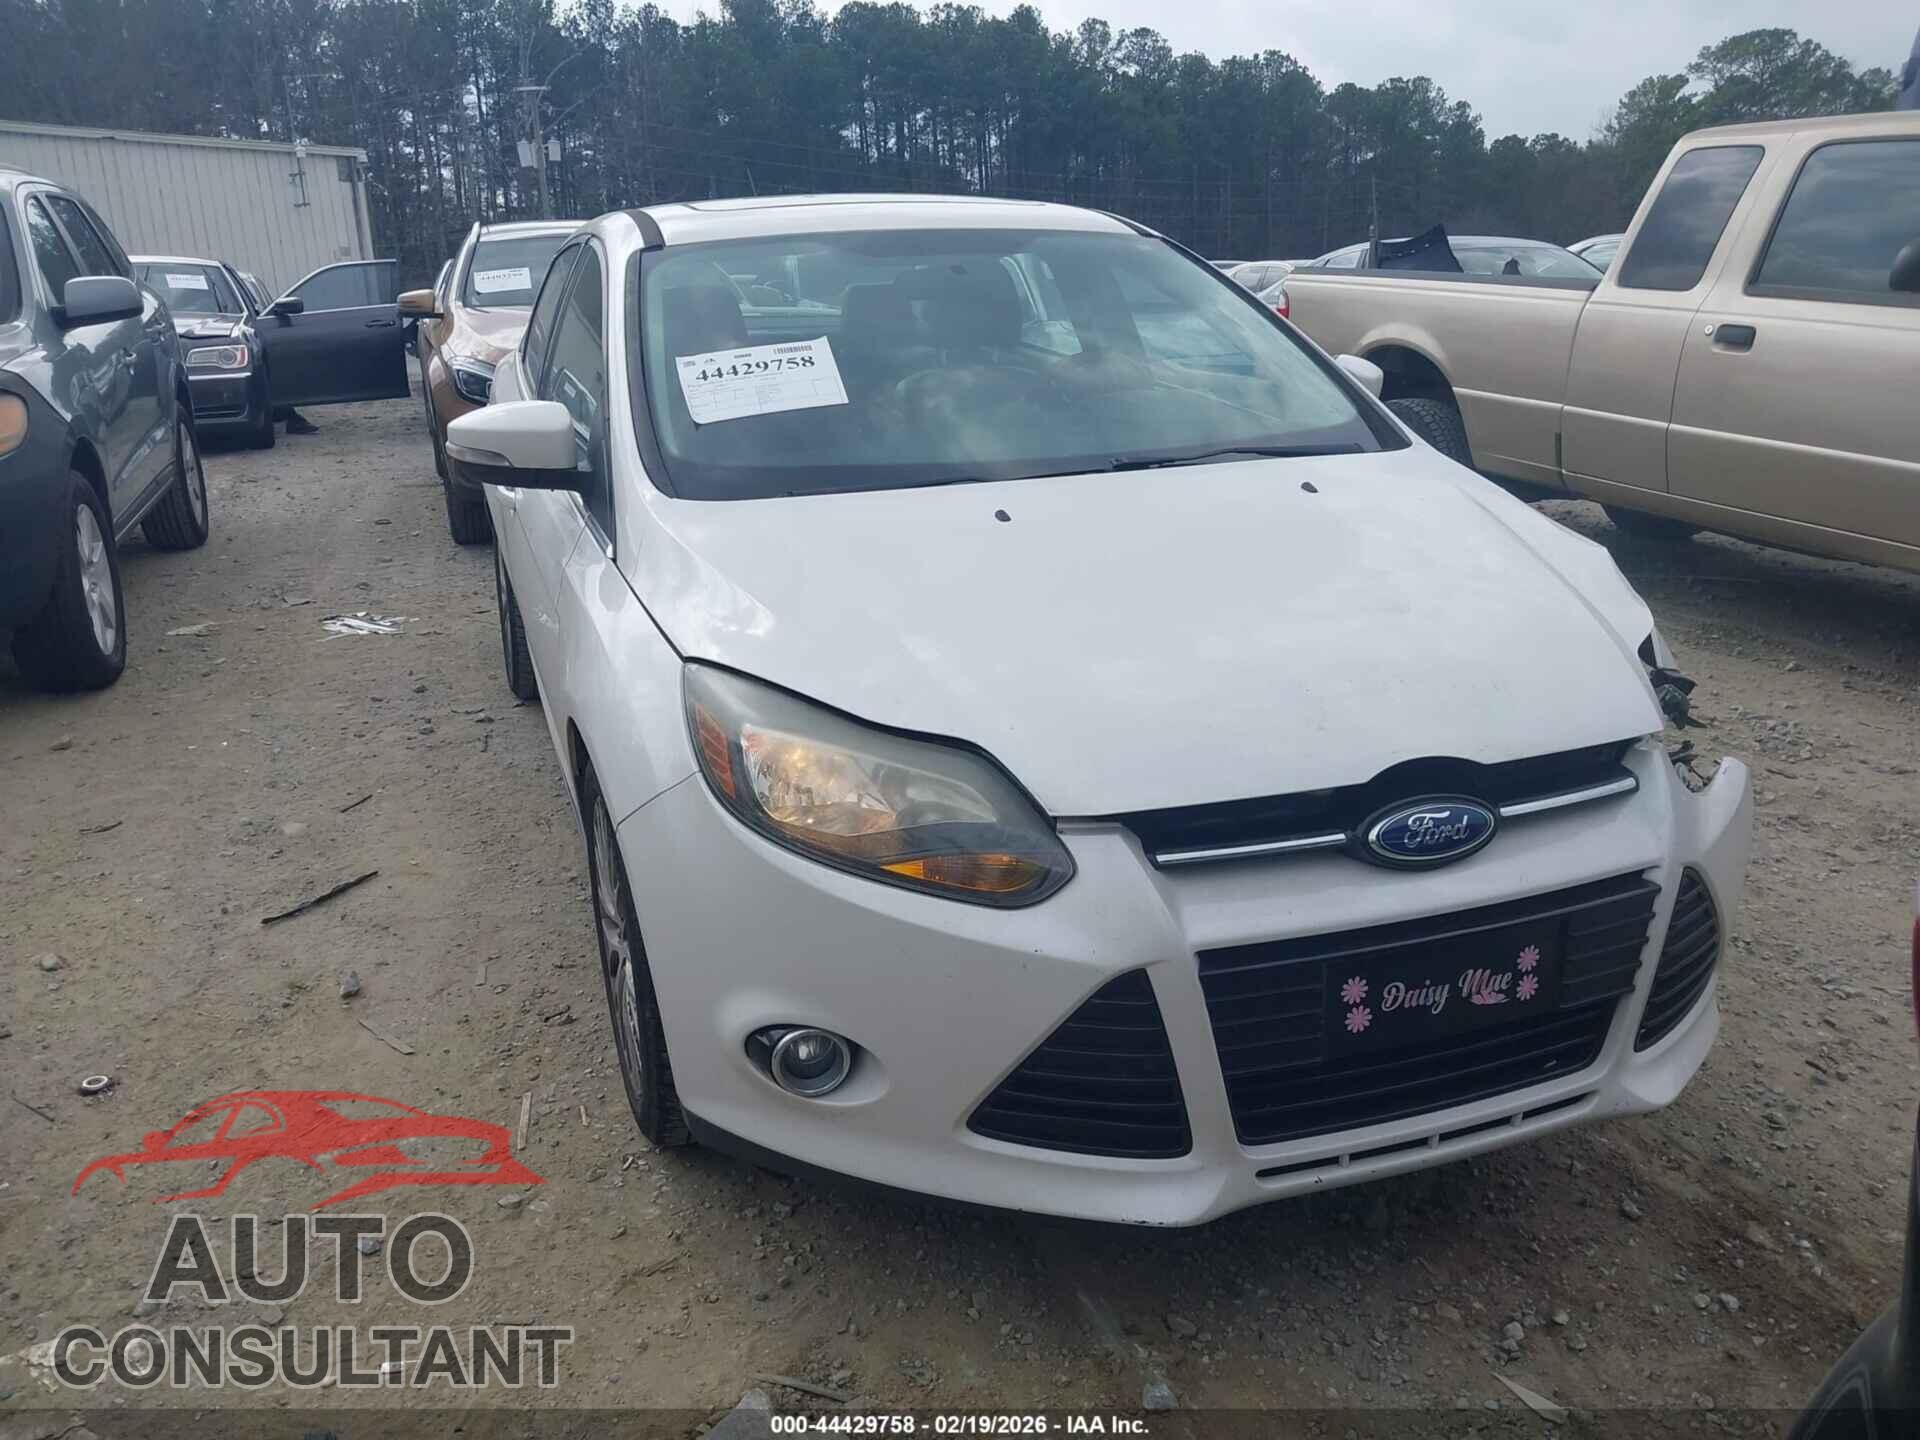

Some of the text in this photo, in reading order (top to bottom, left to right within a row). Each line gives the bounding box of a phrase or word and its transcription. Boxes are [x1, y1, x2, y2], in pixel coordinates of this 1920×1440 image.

[696, 355, 816, 381] 44429758
[1404, 811, 1469, 848] Ford
[1381, 968, 1513, 1014] Daisy Mae
